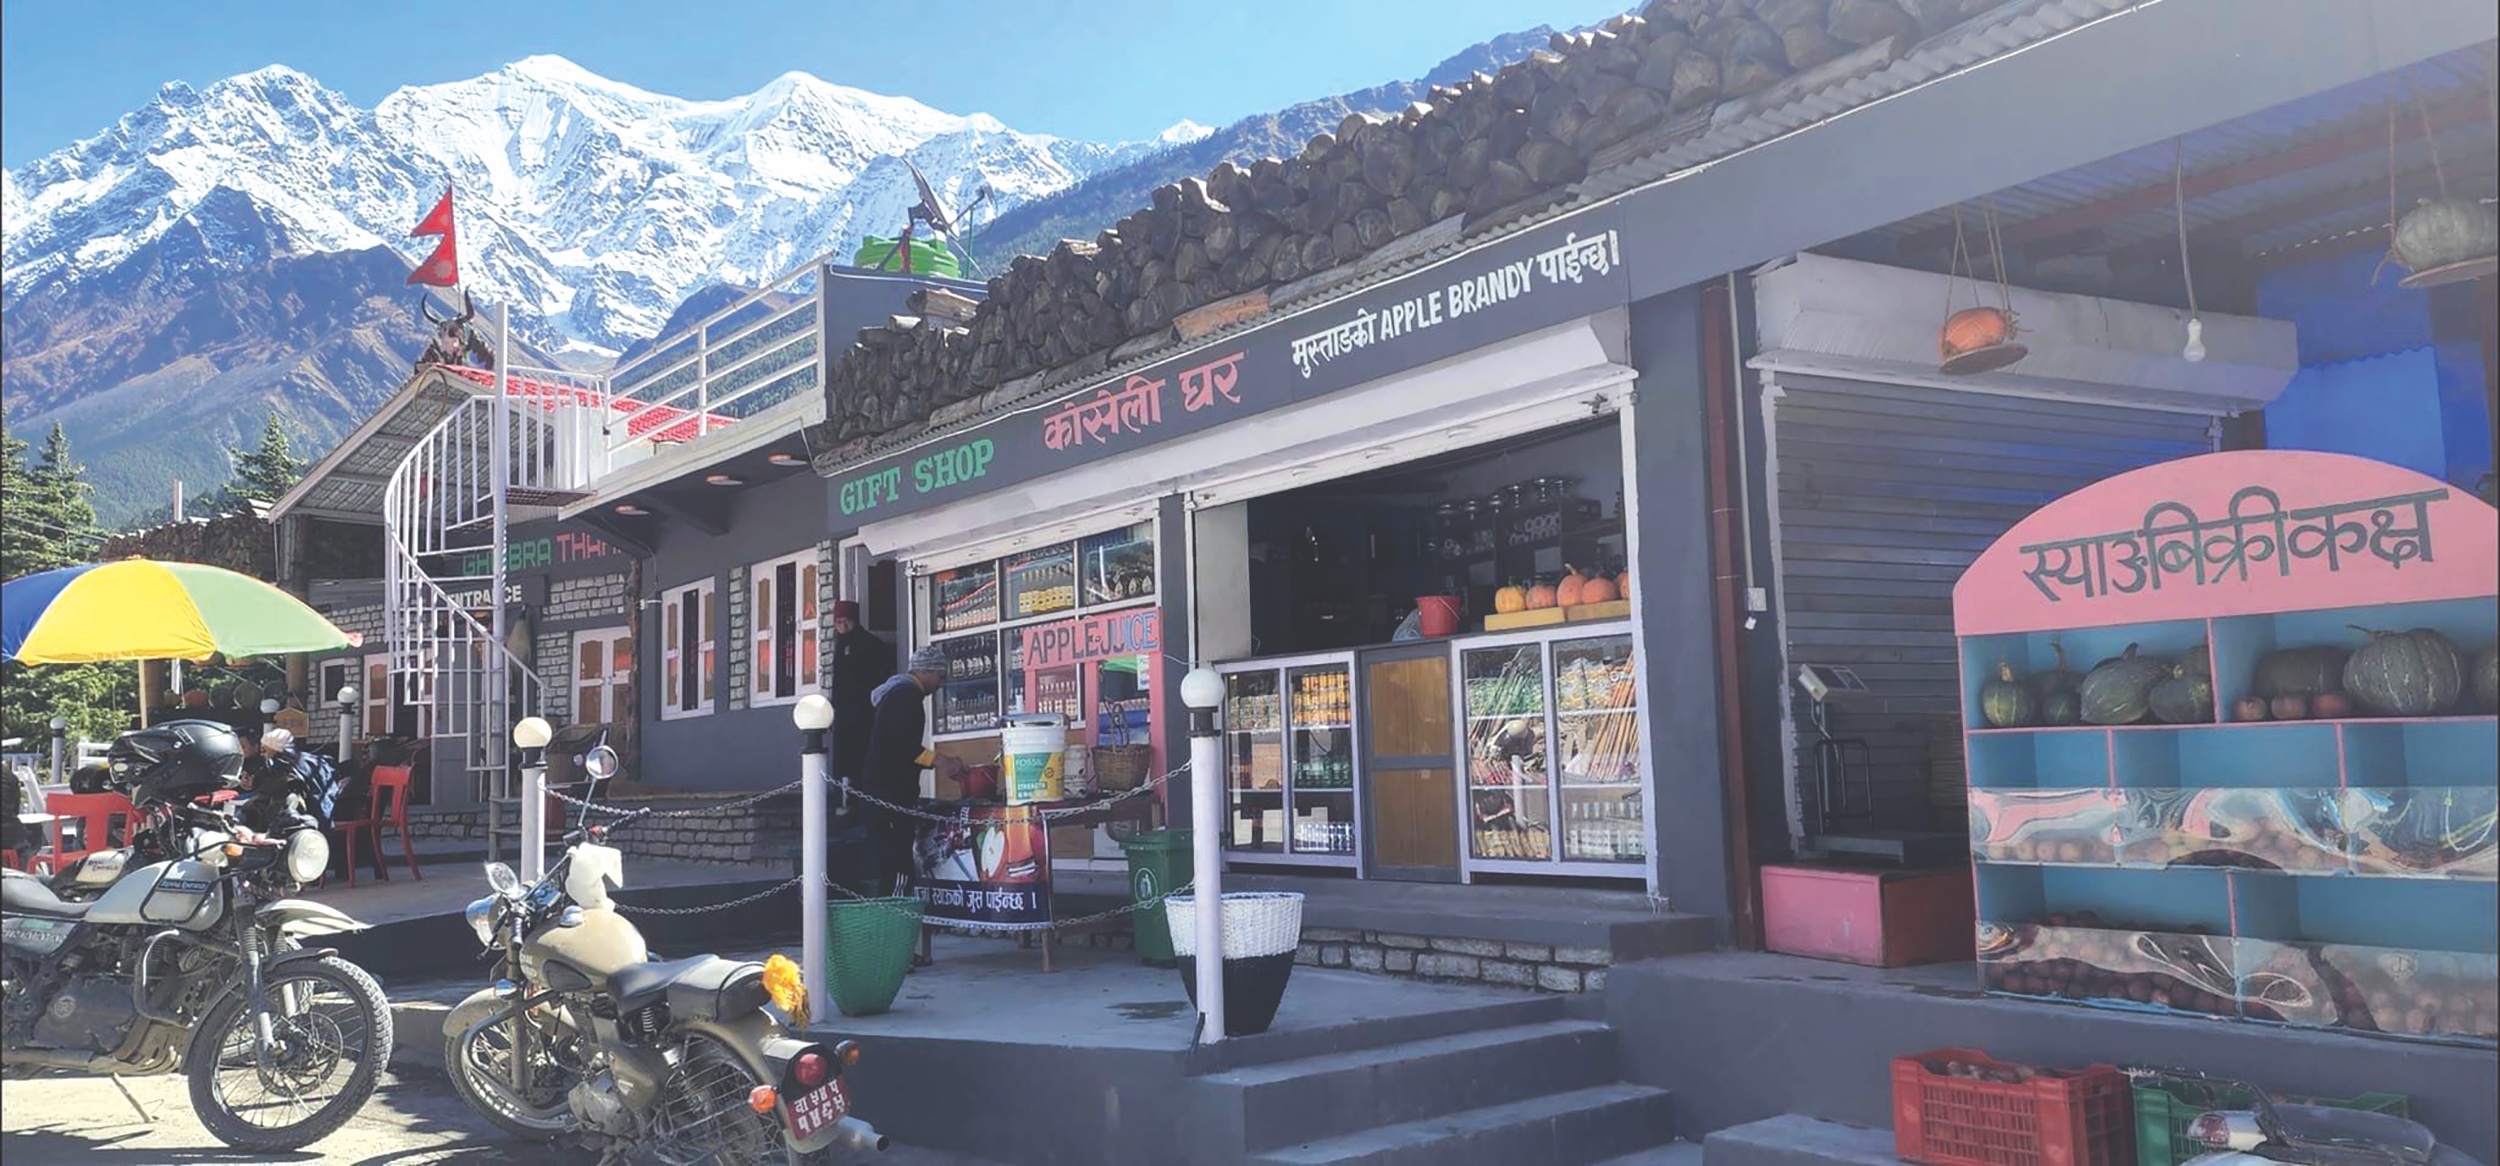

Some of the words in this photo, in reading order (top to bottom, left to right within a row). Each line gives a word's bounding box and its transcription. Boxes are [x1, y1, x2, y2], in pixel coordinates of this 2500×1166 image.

[1380, 291, 1443, 342] APPLE
[1449, 257, 1534, 318] BRANDY
[1043, 375, 1166, 452] कोसेली
[1179, 351, 1245, 412] घर
[839, 467, 900, 515] GIFT
[914, 439, 994, 494] SHOP
[448, 584, 522, 607] ENTRACE
[462, 538, 551, 577] GHBRA
